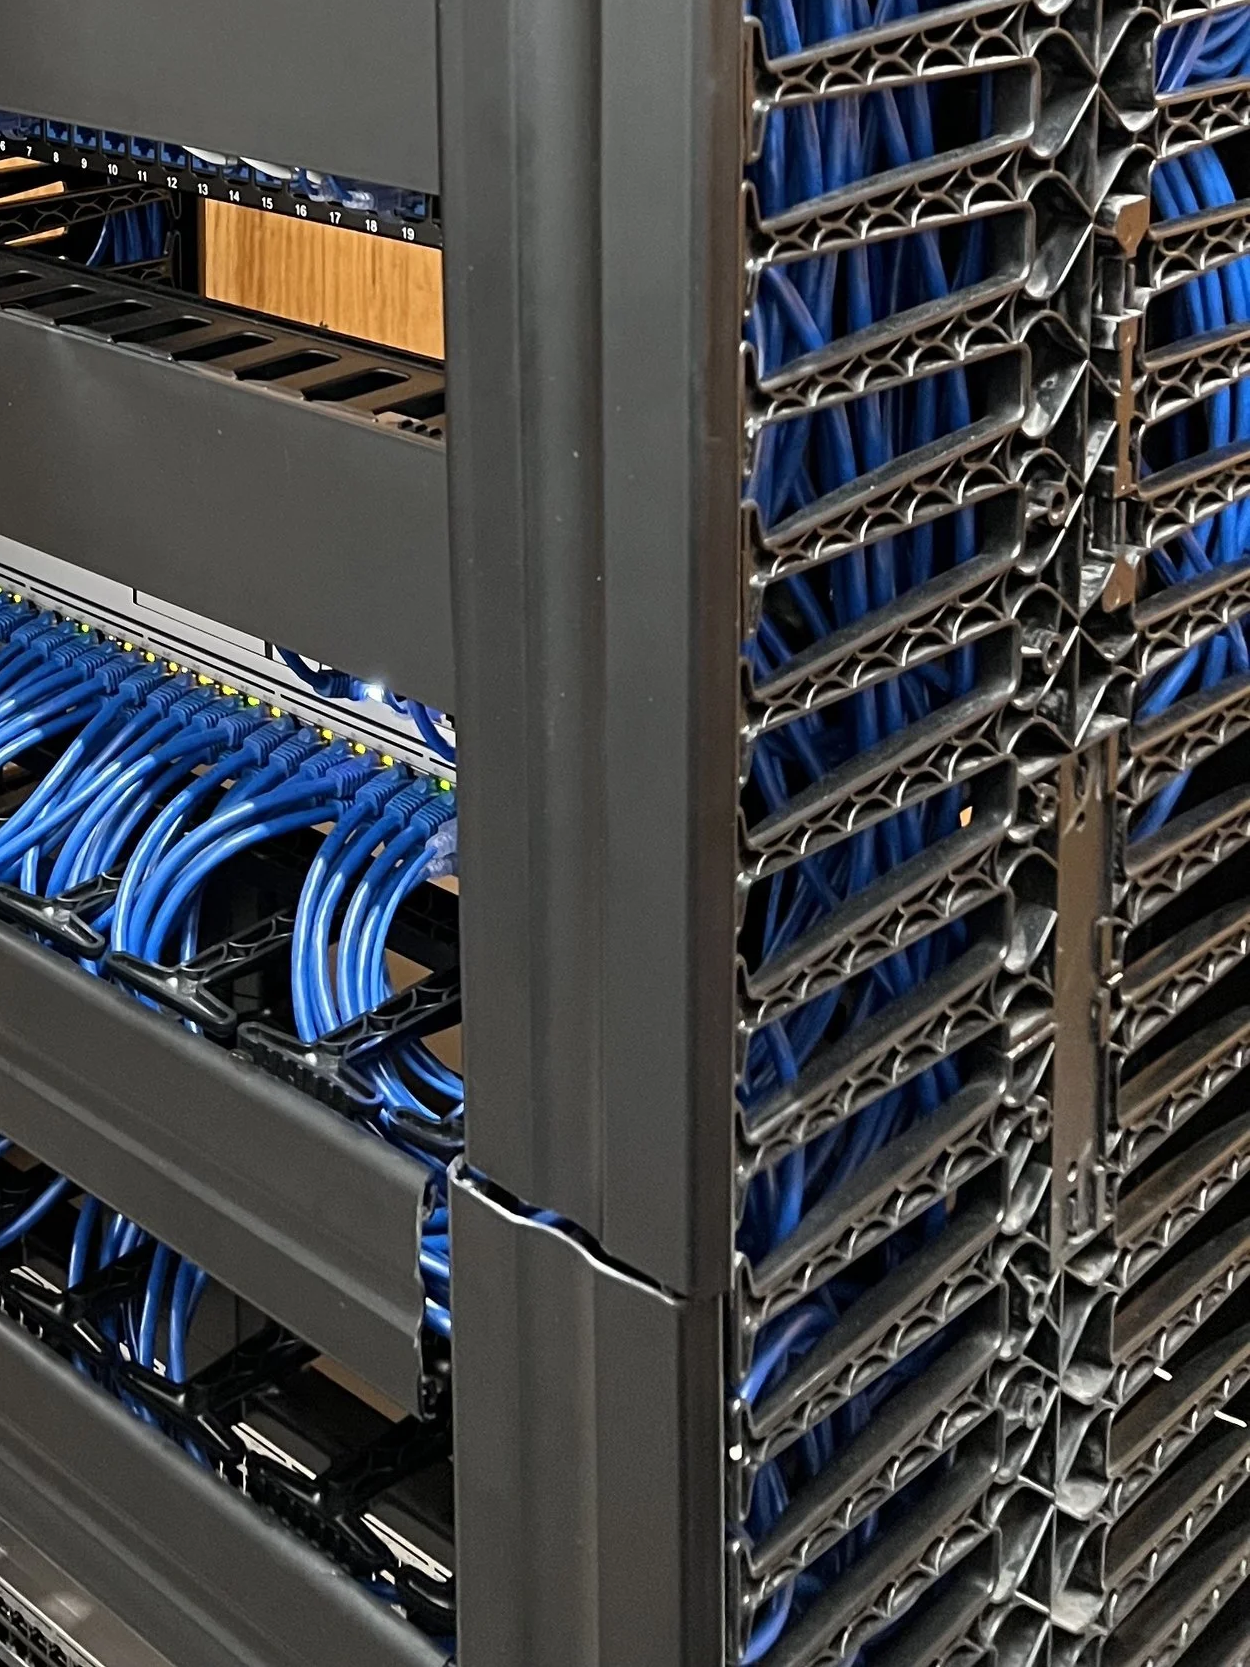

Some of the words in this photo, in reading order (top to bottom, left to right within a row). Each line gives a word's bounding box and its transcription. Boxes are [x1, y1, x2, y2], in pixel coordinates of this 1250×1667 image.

[0, 140, 6, 152] 6
[26, 145, 33, 157] 7
[53, 151, 60, 163] 8
[80, 157, 88, 169] 9
[107, 163, 119, 176] 10
[137, 170, 148, 182] 11
[166, 176, 178, 189] 12
[197, 182, 209, 196] 13
[228, 189, 241, 202] 14
[261, 196, 274, 210] 15
[294, 203, 308, 218] 16
[329, 211, 342, 225] 17
[364, 218, 378, 233] 18
[401, 226, 415, 241] 19
